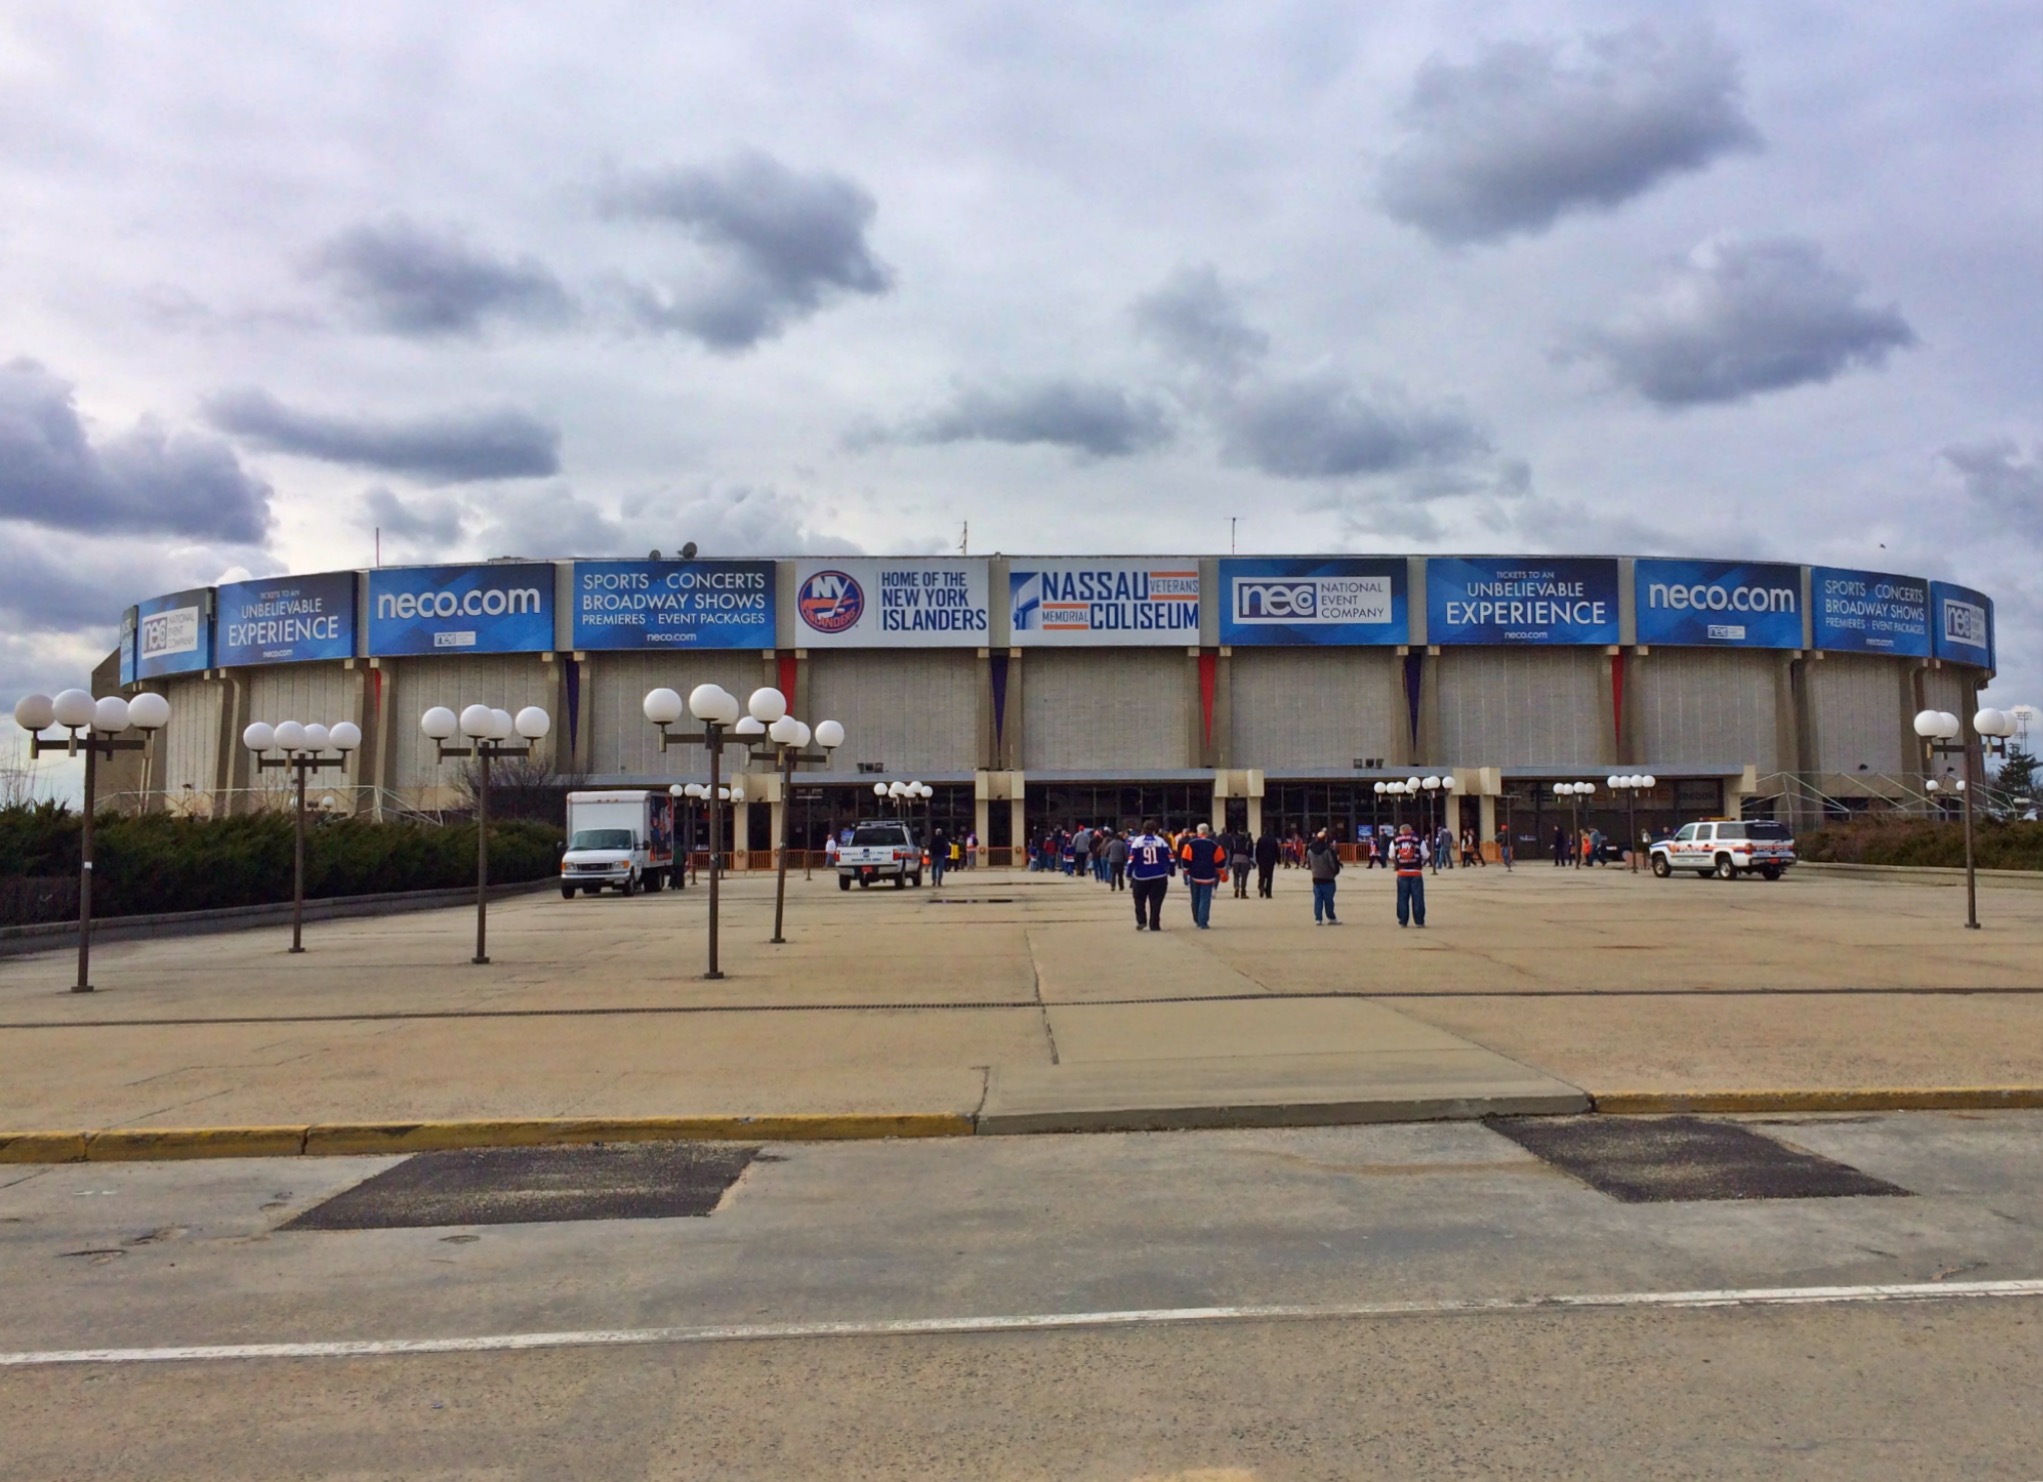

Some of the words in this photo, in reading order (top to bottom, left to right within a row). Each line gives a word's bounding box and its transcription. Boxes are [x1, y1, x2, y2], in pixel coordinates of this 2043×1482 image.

[583, 573, 649, 590] SPORTS
[666, 573, 765, 589] CONCERTS
[881, 572, 919, 587] HOME
[922, 572, 940, 587] OF
[943, 572, 967, 587] THE
[1496, 571, 1527, 579] TICKETS
[1529, 571, 1540, 579] TO
[1541, 571, 1555, 579] AN
[281, 590, 289, 598] TO
[290, 589, 300, 597] AN
[1042, 572, 1149, 600] NASSAU
[1150, 580, 1199, 593] VETERANS
[1321, 582, 1383, 593] NATIONAL
[1467, 582, 1584, 597] UNBELIEVABLE
[1825, 580, 1866, 597] SPORTS
[1875, 584, 1924, 603] CONCERTS
[378, 588, 541, 619] neco.com
[582, 593, 689, 610] BROADWAY
[694, 593, 765, 609] SHOWS
[882, 589, 921, 607] NEW
[924, 589, 969, 607] YORK
[1321, 595, 1358, 605] EVENT
[1649, 584, 1795, 613] neco.com
[241, 598, 322, 619] UNBELIEVABLE
[1042, 610, 1089, 622] MEMORIAL
[1090, 603, 1199, 629] COLISEUM
[1321, 608, 1384, 618] COMPANY
[1446, 601, 1606, 624] EXPERIENCE
[1825, 598, 1888, 617] BROADWAY
[1890, 604, 1925, 621] SHOWS
[582, 613, 646, 625] PREMIERES
[658, 613, 697, 624] EVENT
[700, 613, 765, 624] PACKAGES
[883, 609, 987, 631] ISLANDERS
[1825, 617, 1866, 629] PREMIERES
[1872, 620, 1893, 631] EVENT
[1894, 622, 1925, 635] PACKAGES
[228, 616, 339, 646] EXPERIENCE
[646, 632, 697, 642] neco.com
[1504, 631, 1548, 639] neco.com
[1143, 847, 1158, 864] 91
